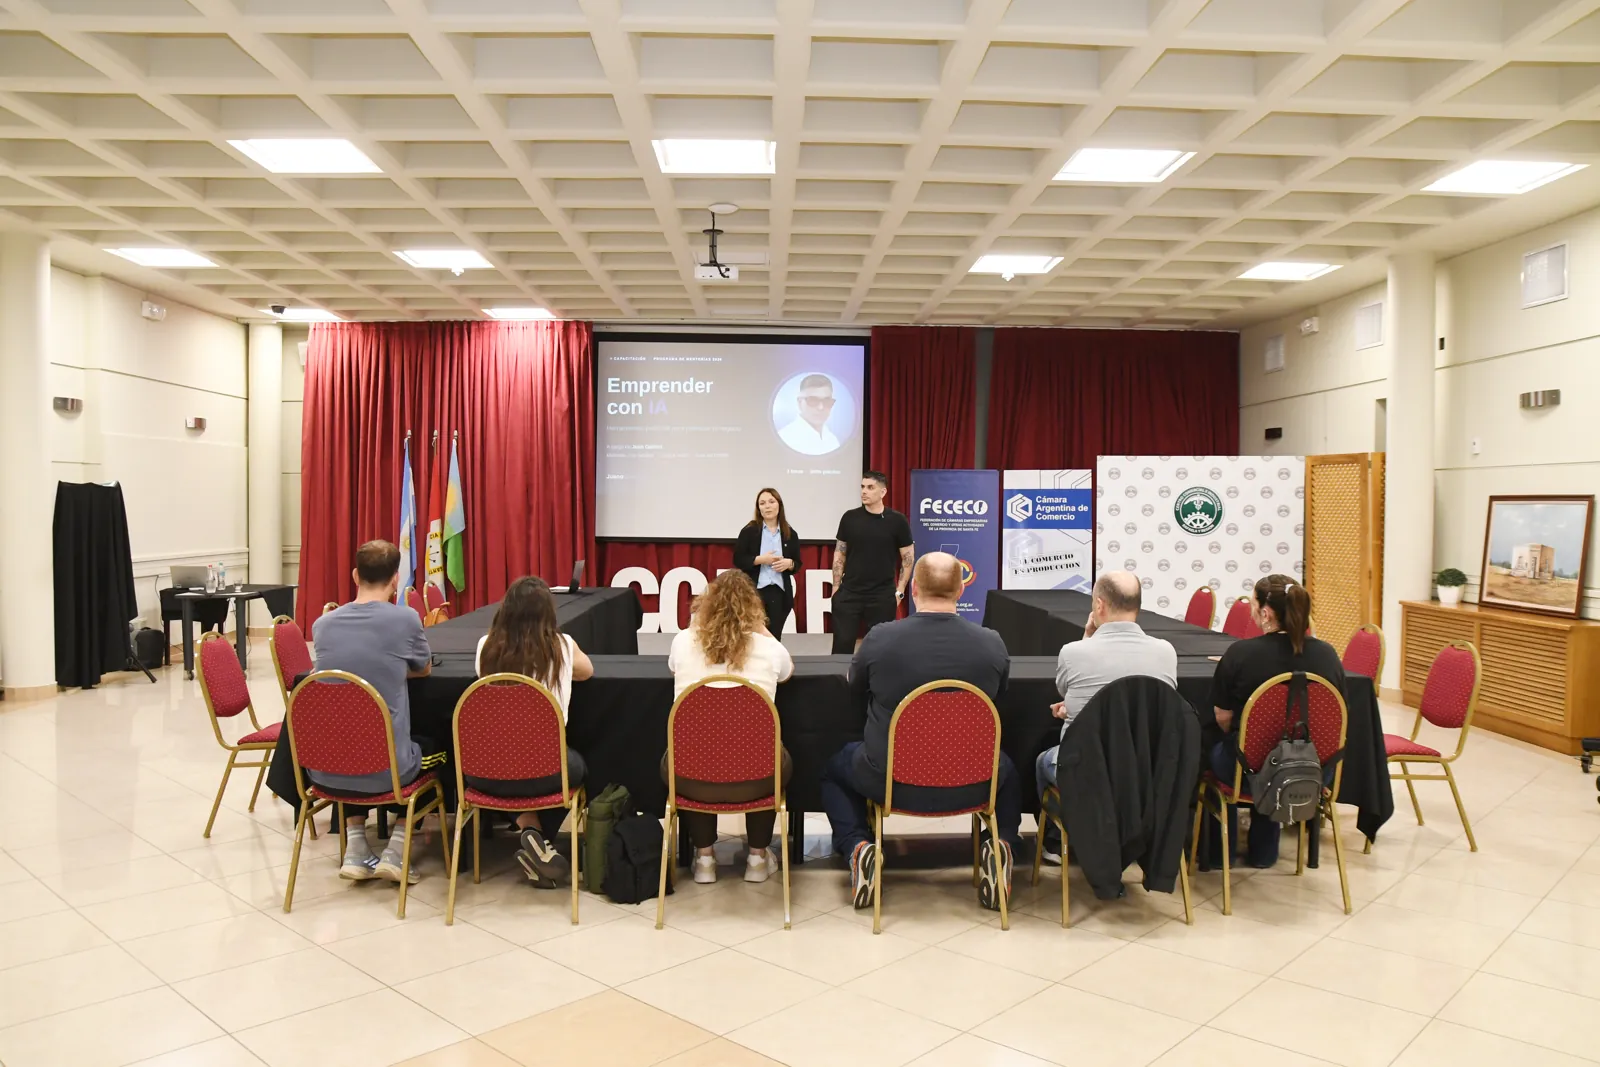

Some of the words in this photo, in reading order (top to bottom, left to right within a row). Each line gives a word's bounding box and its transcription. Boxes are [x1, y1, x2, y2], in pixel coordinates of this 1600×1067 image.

[607, 377, 714, 398] Emprender
[607, 402, 643, 415] con
[648, 398, 668, 415] IA
[920, 498, 988, 515] FECECO
[1036, 496, 1068, 504] Cámara
[1036, 504, 1076, 514] Argentina
